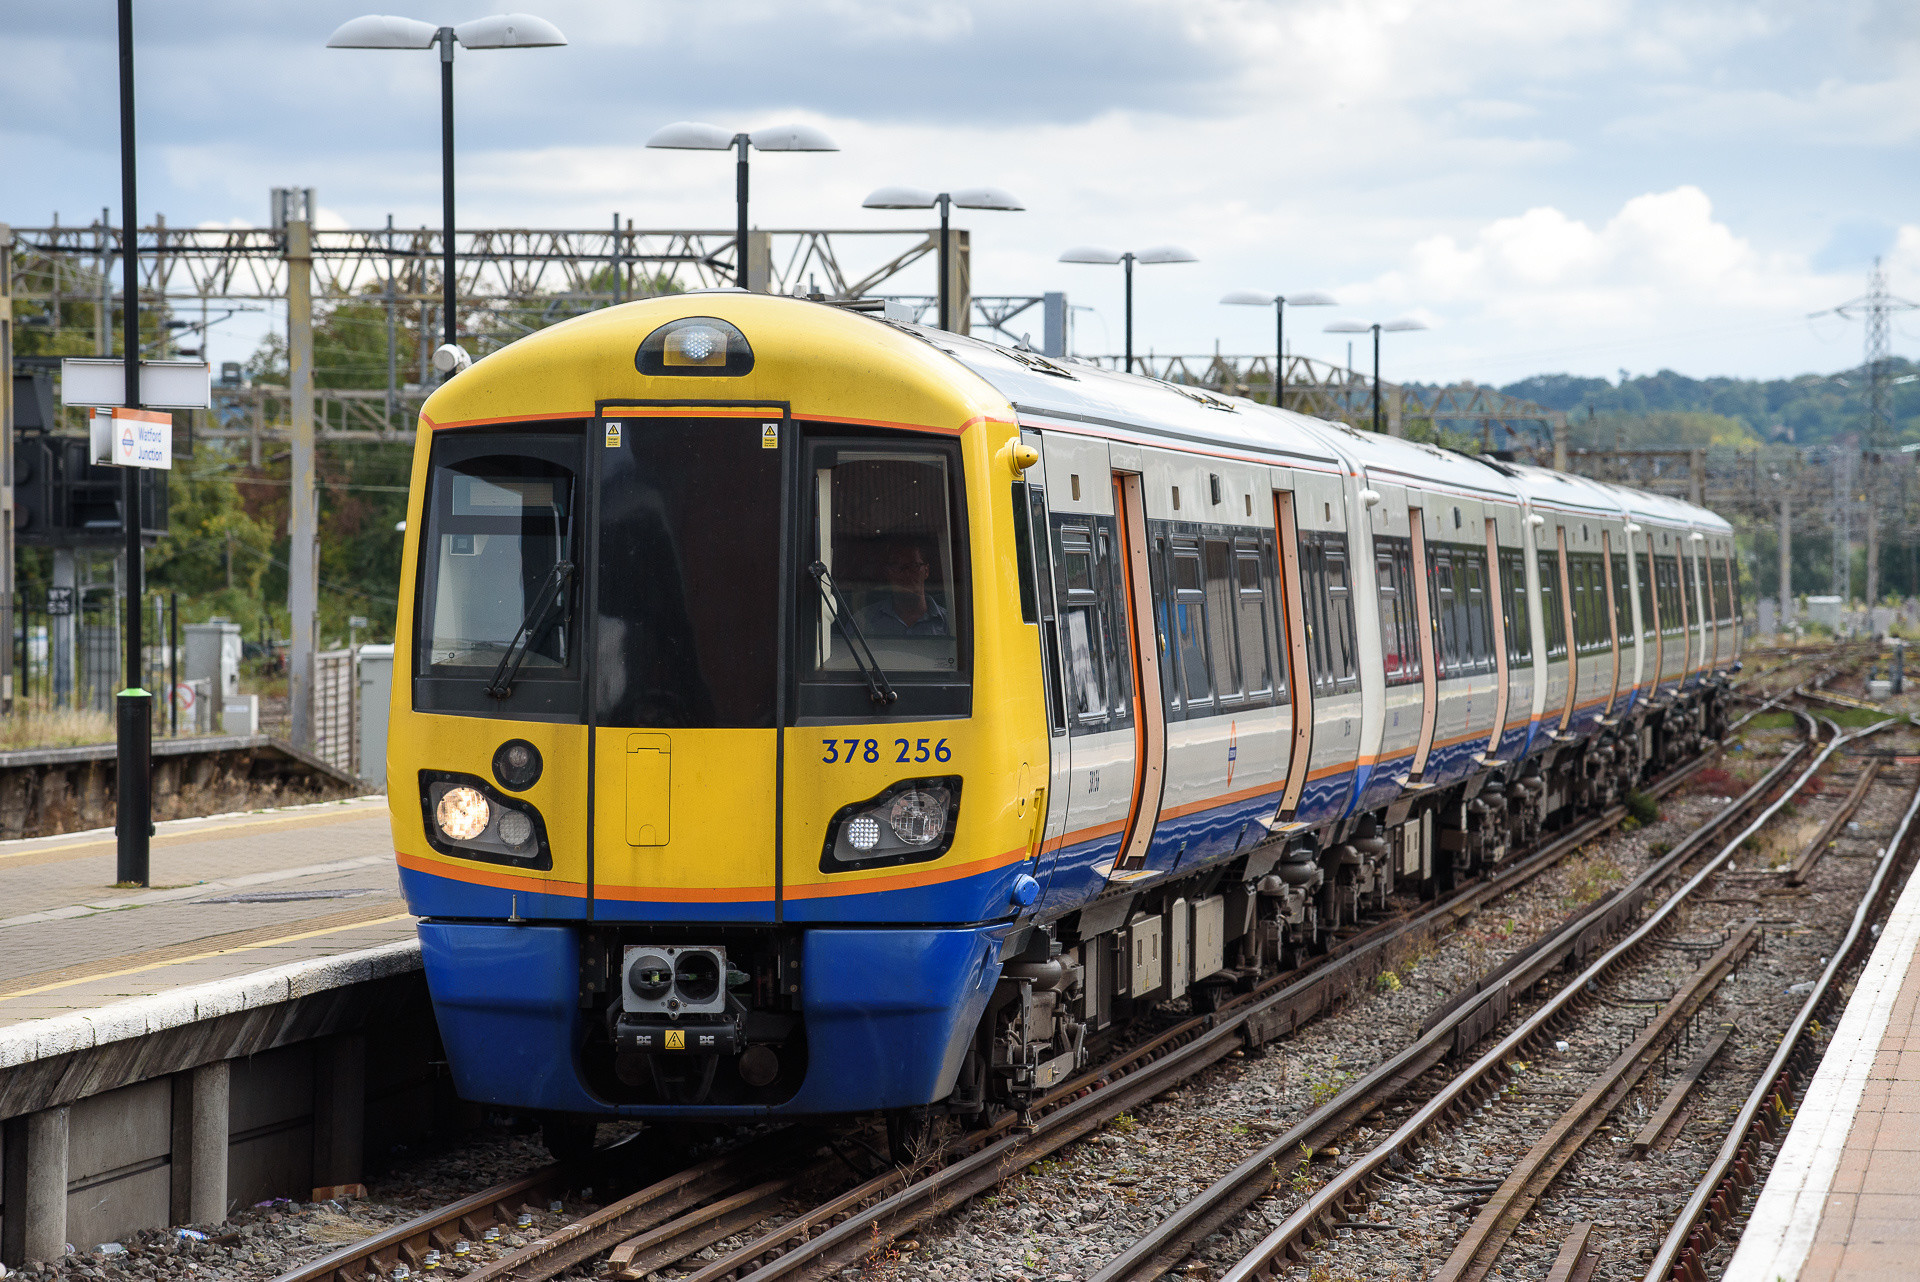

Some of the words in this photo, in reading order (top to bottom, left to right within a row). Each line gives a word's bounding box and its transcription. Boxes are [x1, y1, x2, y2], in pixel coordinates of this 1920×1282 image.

[138, 427, 162, 443] Watford
[138, 446, 162, 462] Junction
[822, 738, 880, 764] 378
[894, 738, 952, 763] 256
